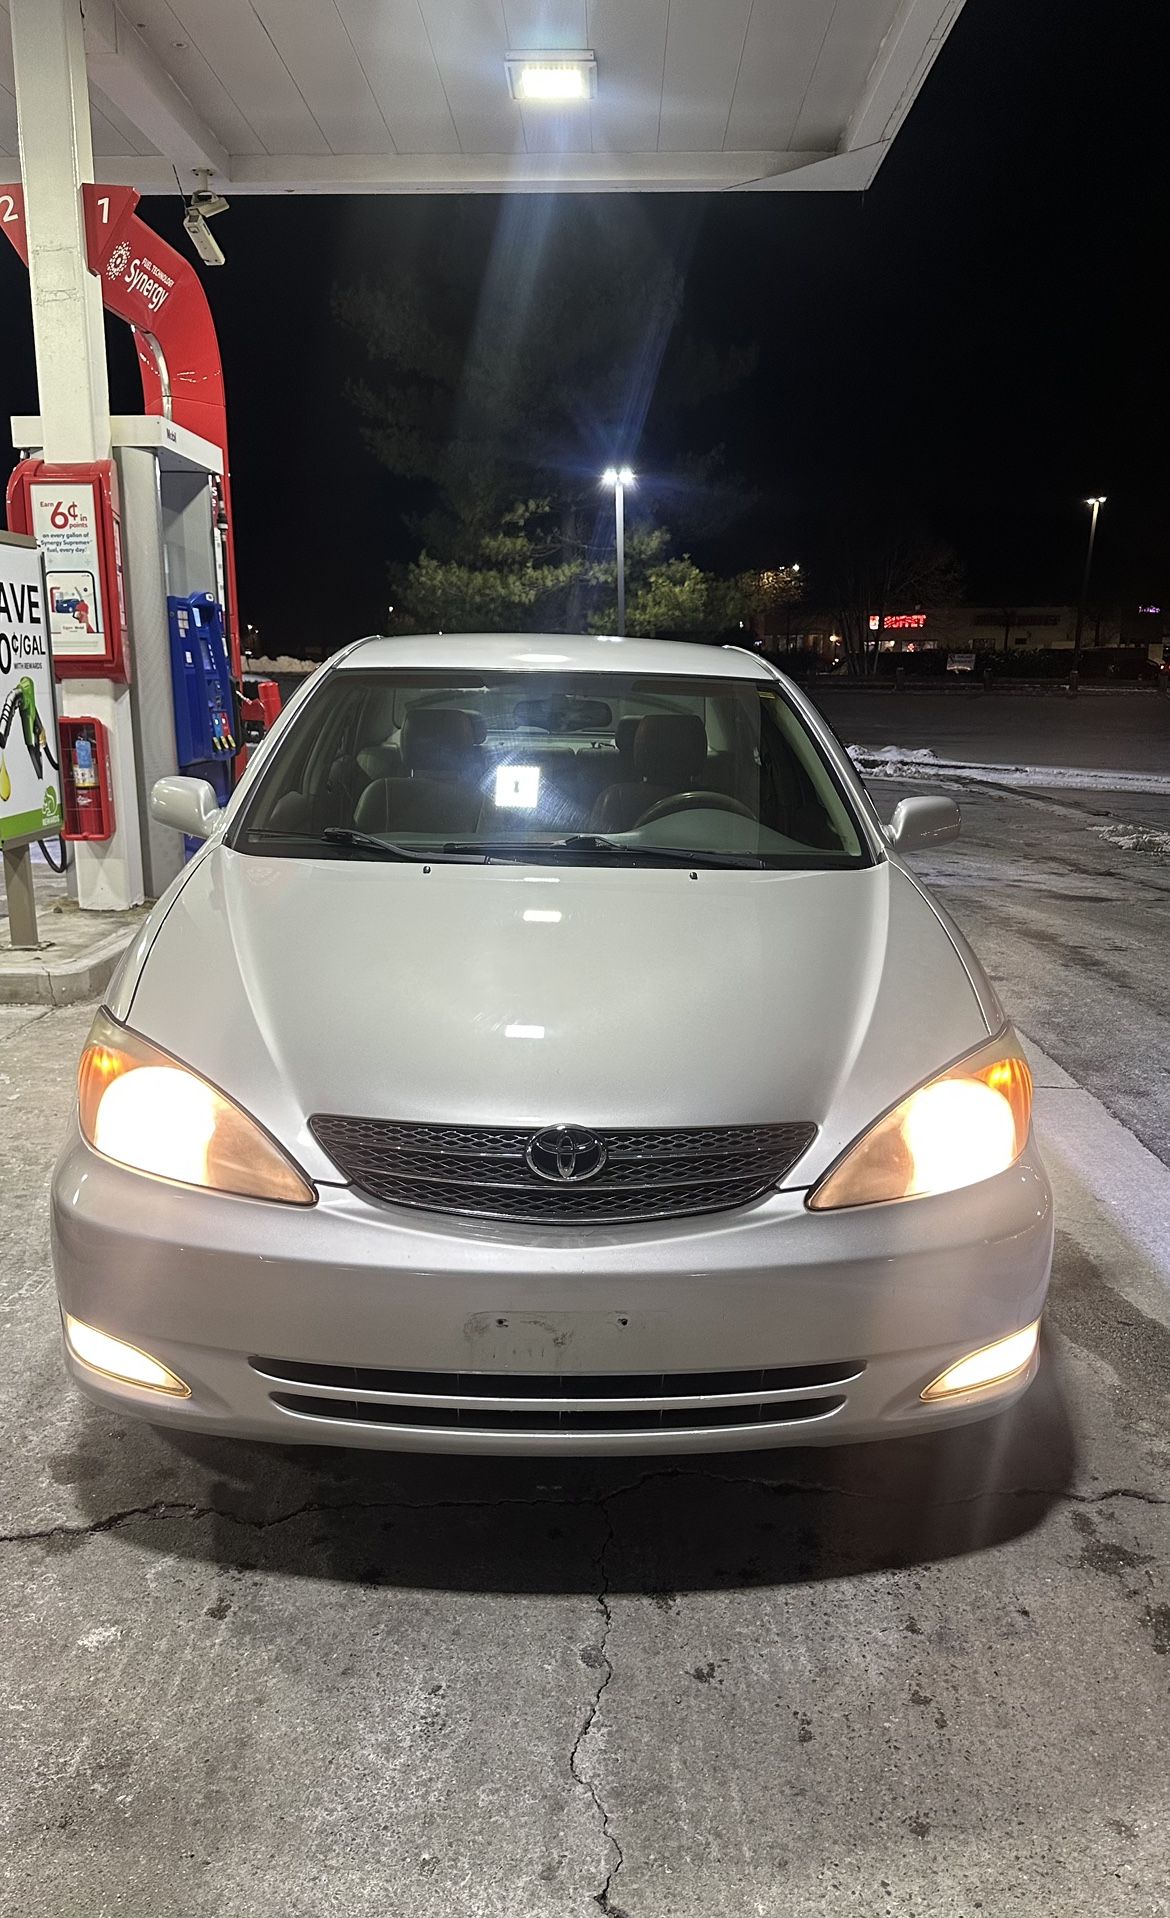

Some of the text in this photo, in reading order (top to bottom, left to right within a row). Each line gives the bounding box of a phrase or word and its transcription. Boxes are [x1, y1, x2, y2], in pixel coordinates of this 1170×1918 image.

[0, 195, 19, 223] 2
[97, 197, 110, 224] 1
[124, 258, 169, 313] Synergy
[141, 257, 175, 288] FUEL TECHNOLOGY
[69, 521, 88, 529] points
[80, 513, 88, 521] in
[883, 614, 927, 629] BUFFET
